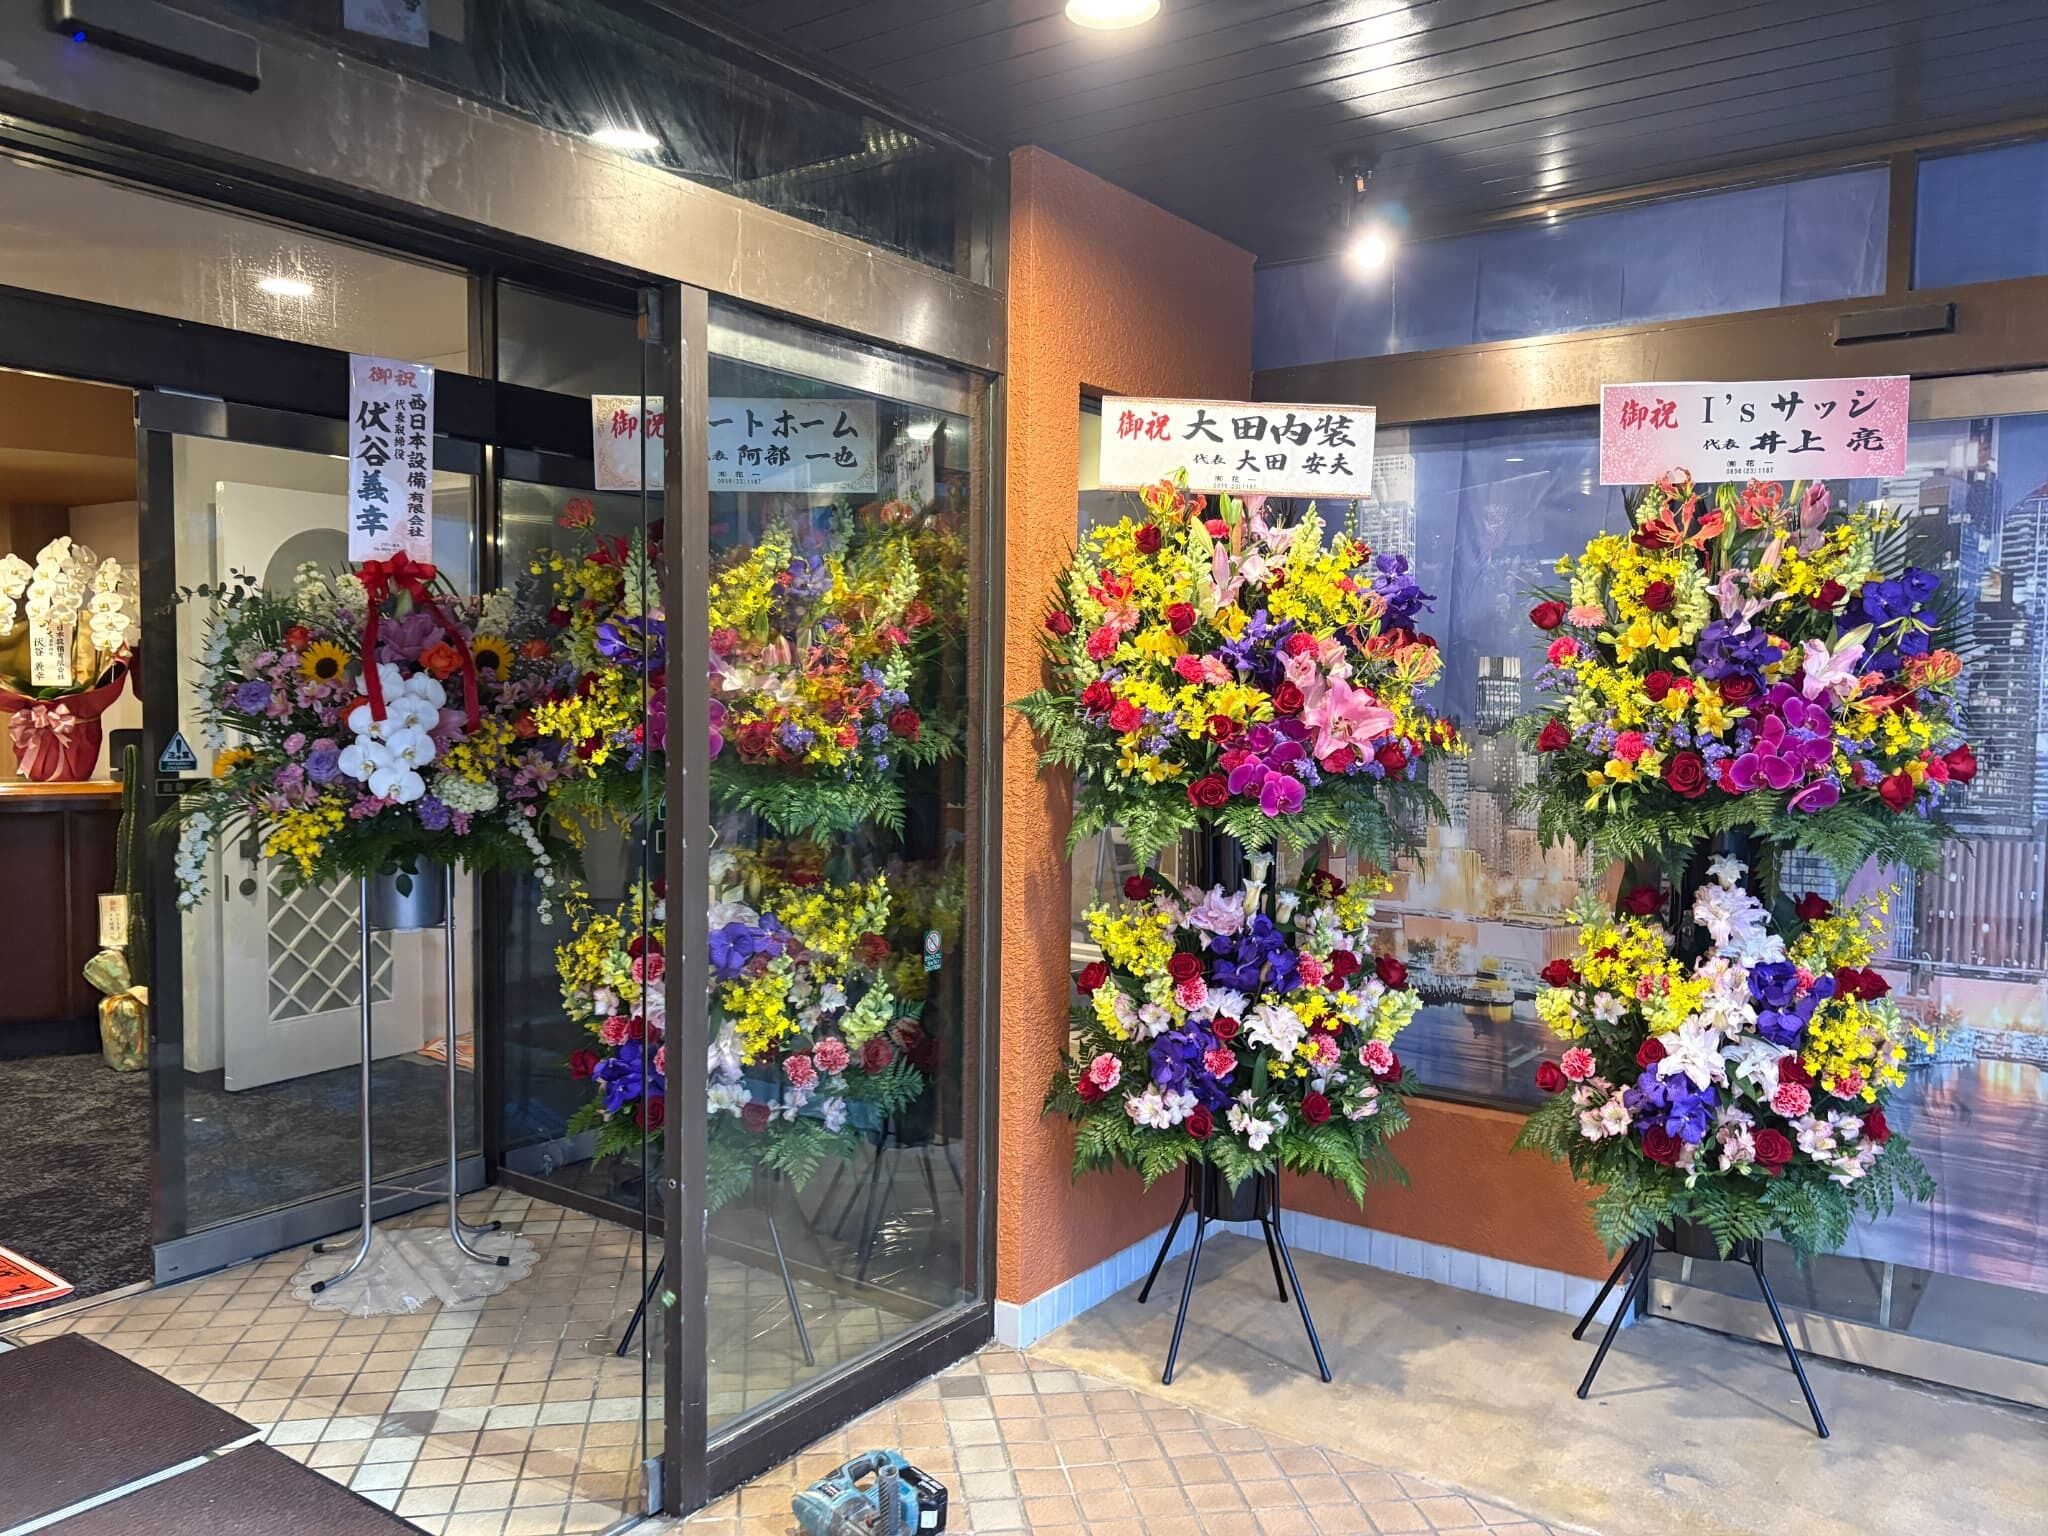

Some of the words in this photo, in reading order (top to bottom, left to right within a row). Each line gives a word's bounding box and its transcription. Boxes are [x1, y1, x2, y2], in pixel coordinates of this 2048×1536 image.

[368, 366, 418, 389] 御祝
[1620, 398, 1679, 430] 御祝
[1771, 389, 1879, 422] サッシ
[393, 399, 406, 461] 代表取締役
[610, 408, 665, 440] 御祝
[1116, 409, 1171, 442] 御祝
[1182, 409, 1356, 448] 大田内装
[707, 449, 729, 461] 表
[1192, 453, 1226, 466] 代表
[1702, 438, 1740, 450] 代表
[355, 400, 392, 538] 伏谷義幸
[407, 393, 427, 538] 西日本設備有限会社
